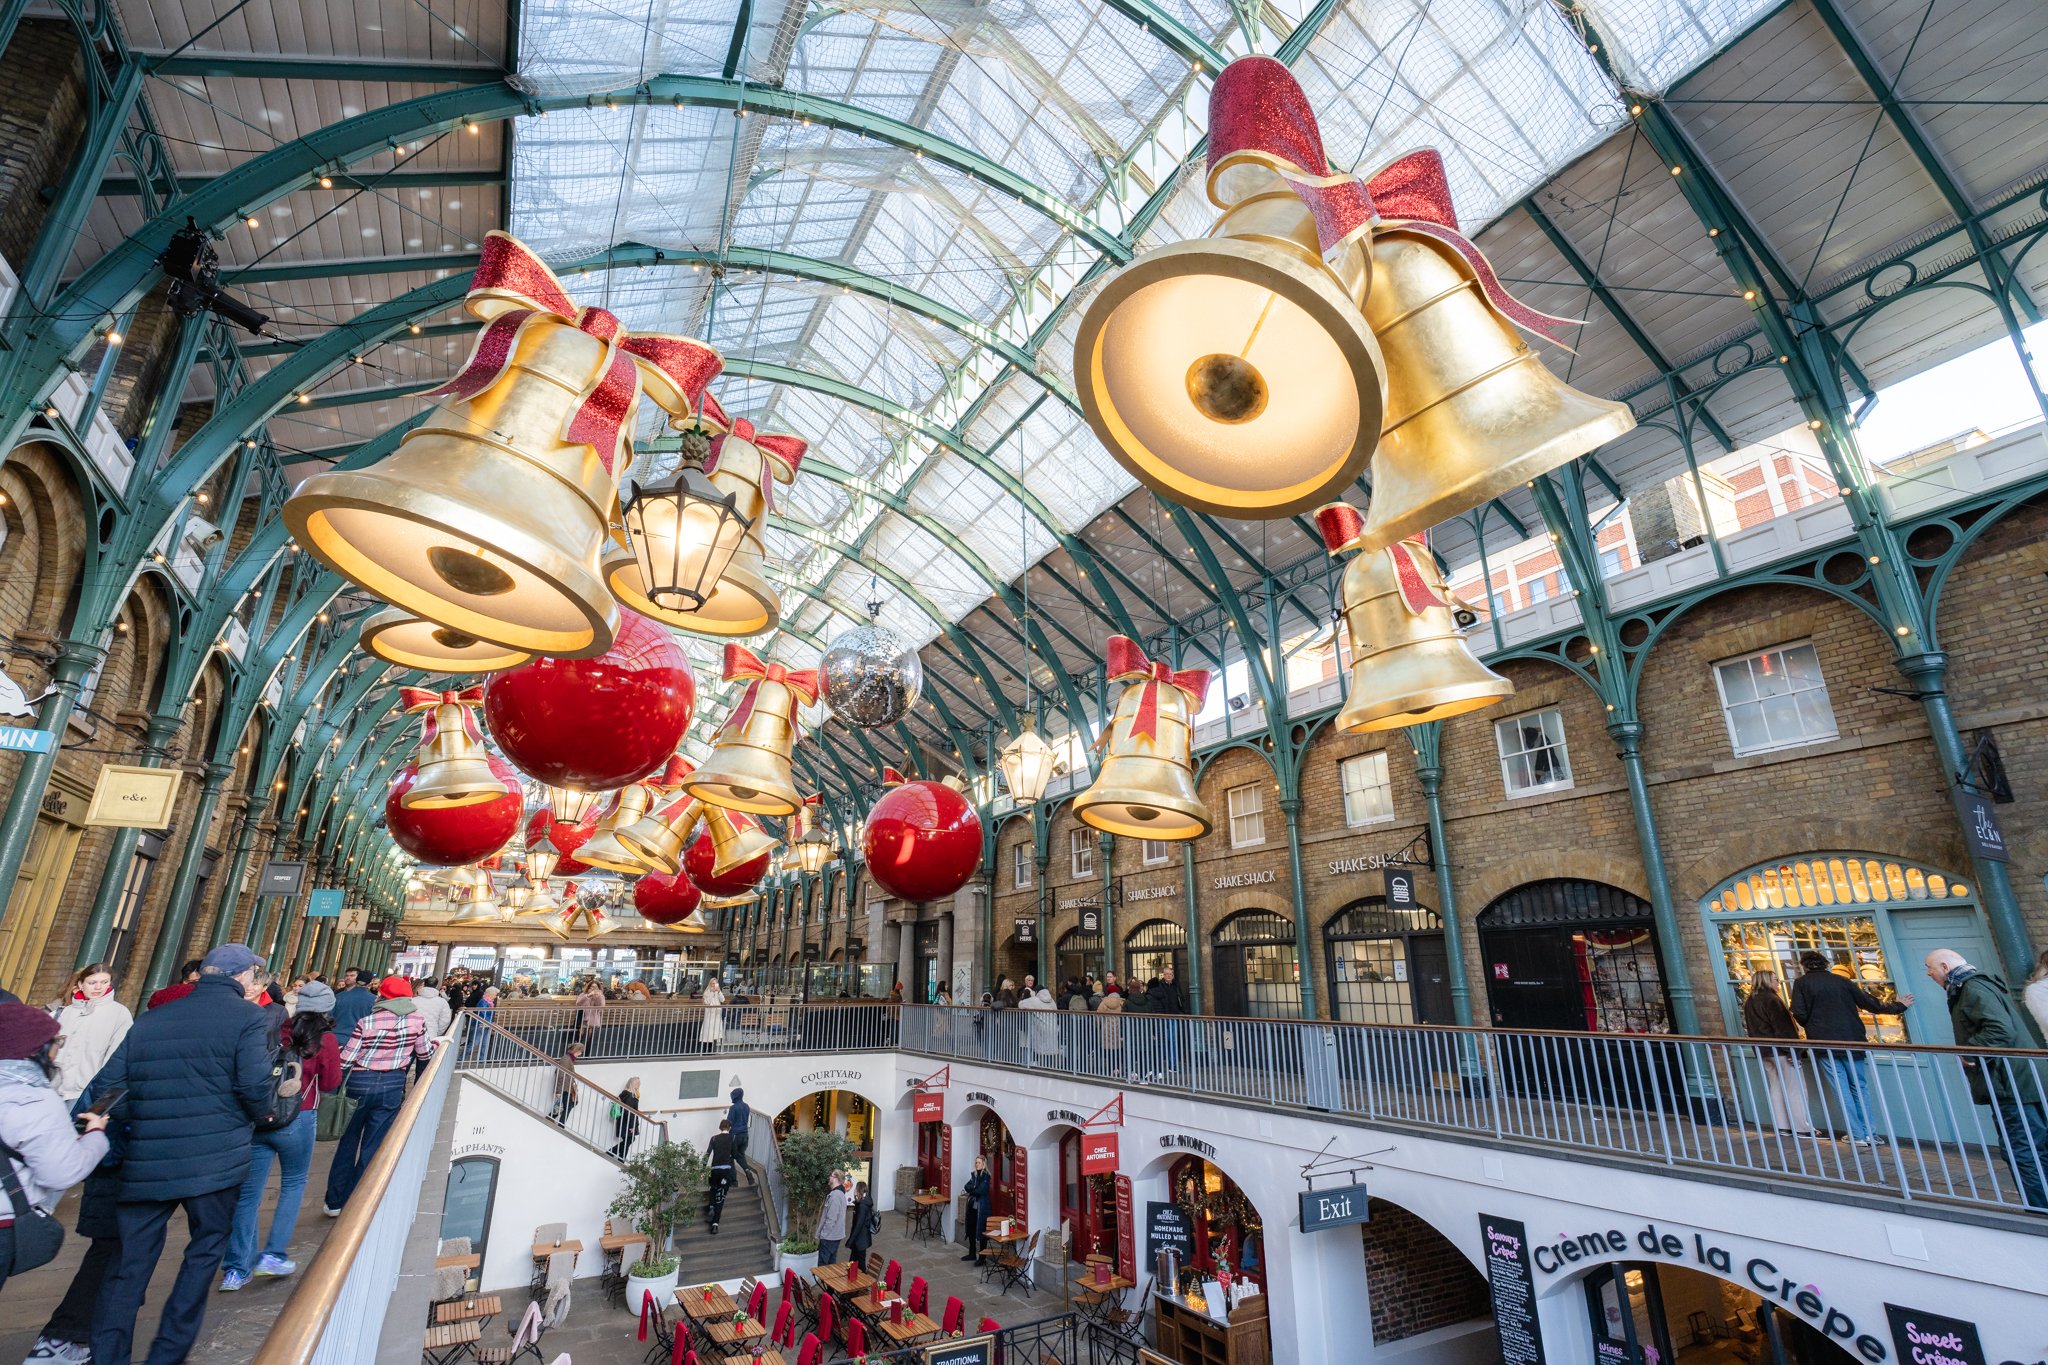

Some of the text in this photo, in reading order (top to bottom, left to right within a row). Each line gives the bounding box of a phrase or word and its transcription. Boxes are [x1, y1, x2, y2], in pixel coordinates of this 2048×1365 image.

[1328, 857, 1368, 875] SHAKE
[1214, 870, 1276, 889] SHAKE SHACK
[1127, 885, 1176, 901] SHAKE SHACK
[1059, 899, 1078, 910] SHAKE
[801, 1069, 862, 1084] COURTYARD
[1093, 1146, 1107, 1154] CHEZ
[1177, 1134, 1217, 1160] ANTOINETTE
[1086, 1152, 1115, 1161] ANTOINETTE
[1318, 1194, 1352, 1221] Exit
[1151, 1232, 1172, 1240] MULLED
[1154, 1225, 1184, 1234] HOMEMADE
[1487, 1225, 1521, 1250] Savoury
[1533, 1224, 1887, 1364] Crème de la Crêpe
[1905, 1321, 1963, 1352] Sweet
[1599, 1342, 1623, 1356] Wines
